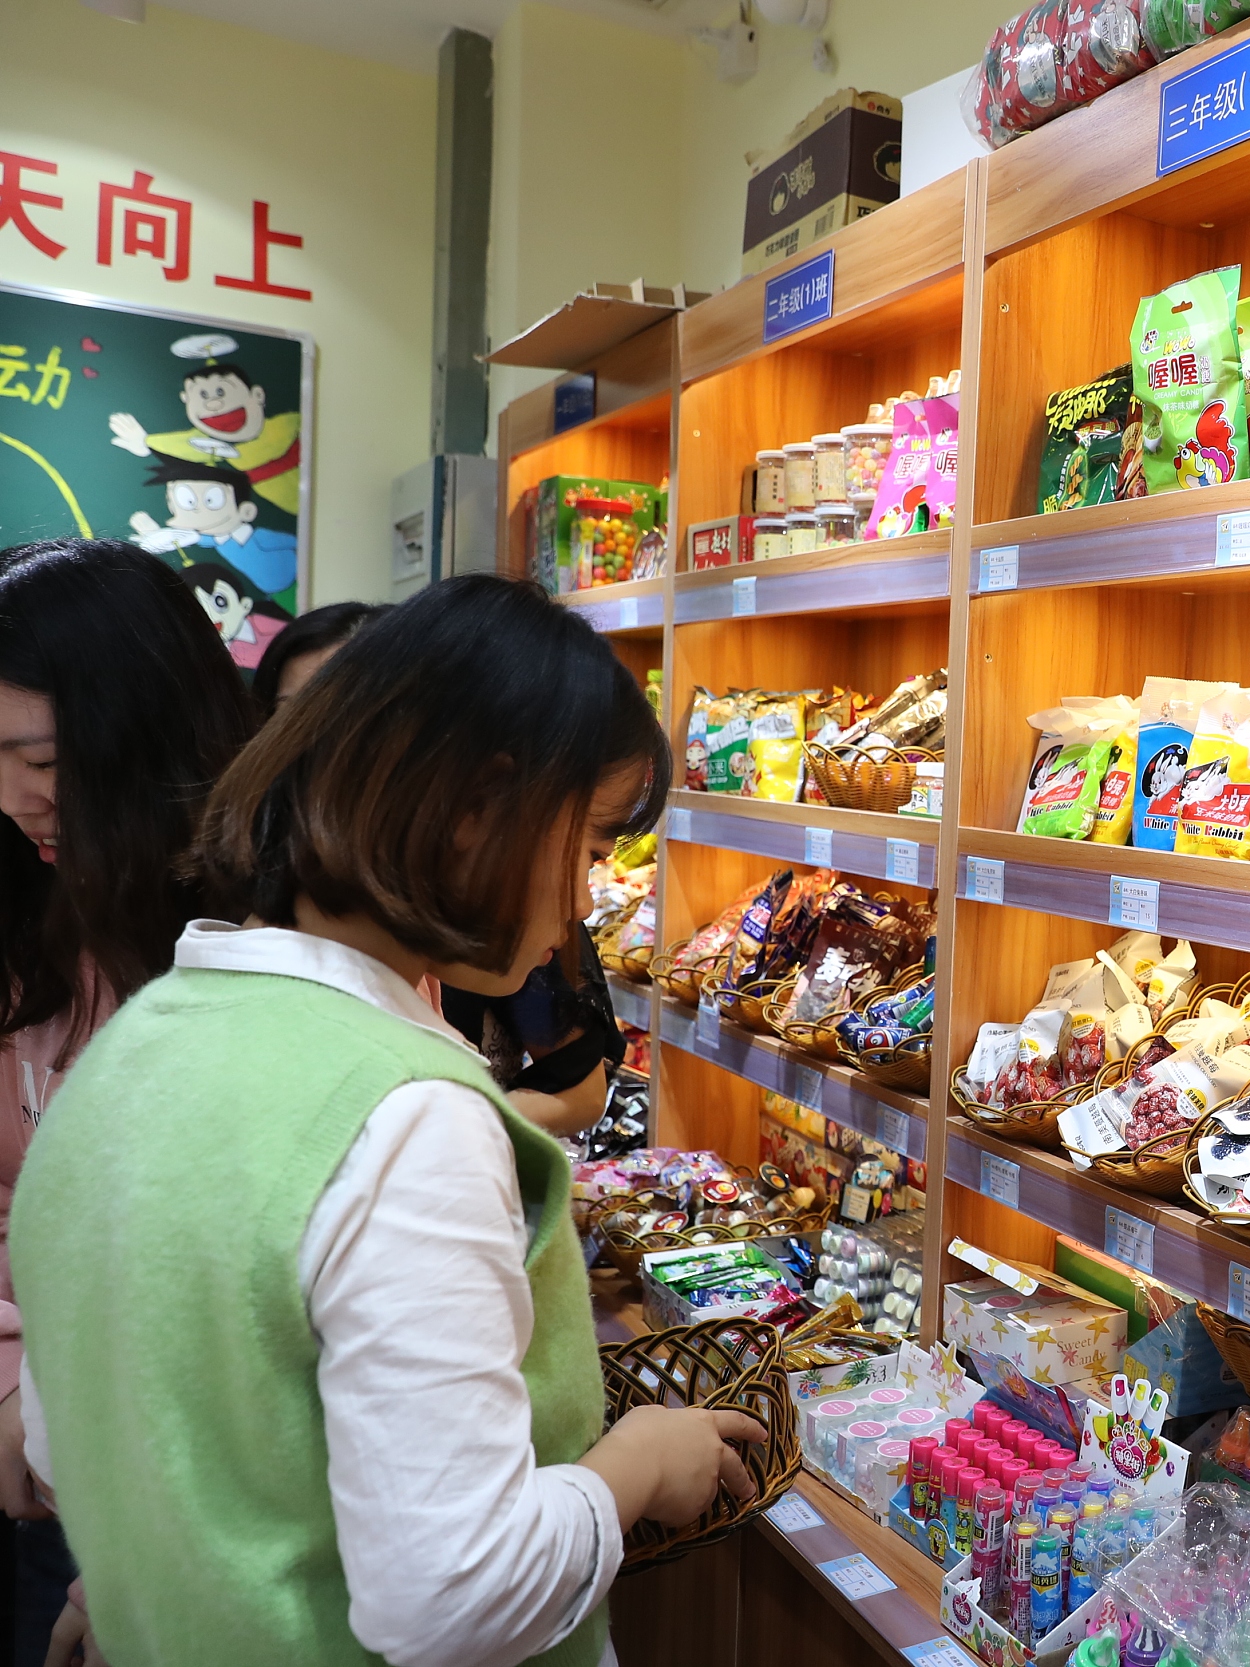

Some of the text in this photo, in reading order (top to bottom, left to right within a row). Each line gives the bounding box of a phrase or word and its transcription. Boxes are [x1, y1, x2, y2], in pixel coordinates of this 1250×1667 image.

[1147, 354, 1198, 390] 喔喔
[1144, 817, 1170, 831] White
[1205, 825, 1244, 841] Rabbit
[1057, 1338, 1092, 1353] Sweet
[1069, 1351, 1106, 1367] Candy
